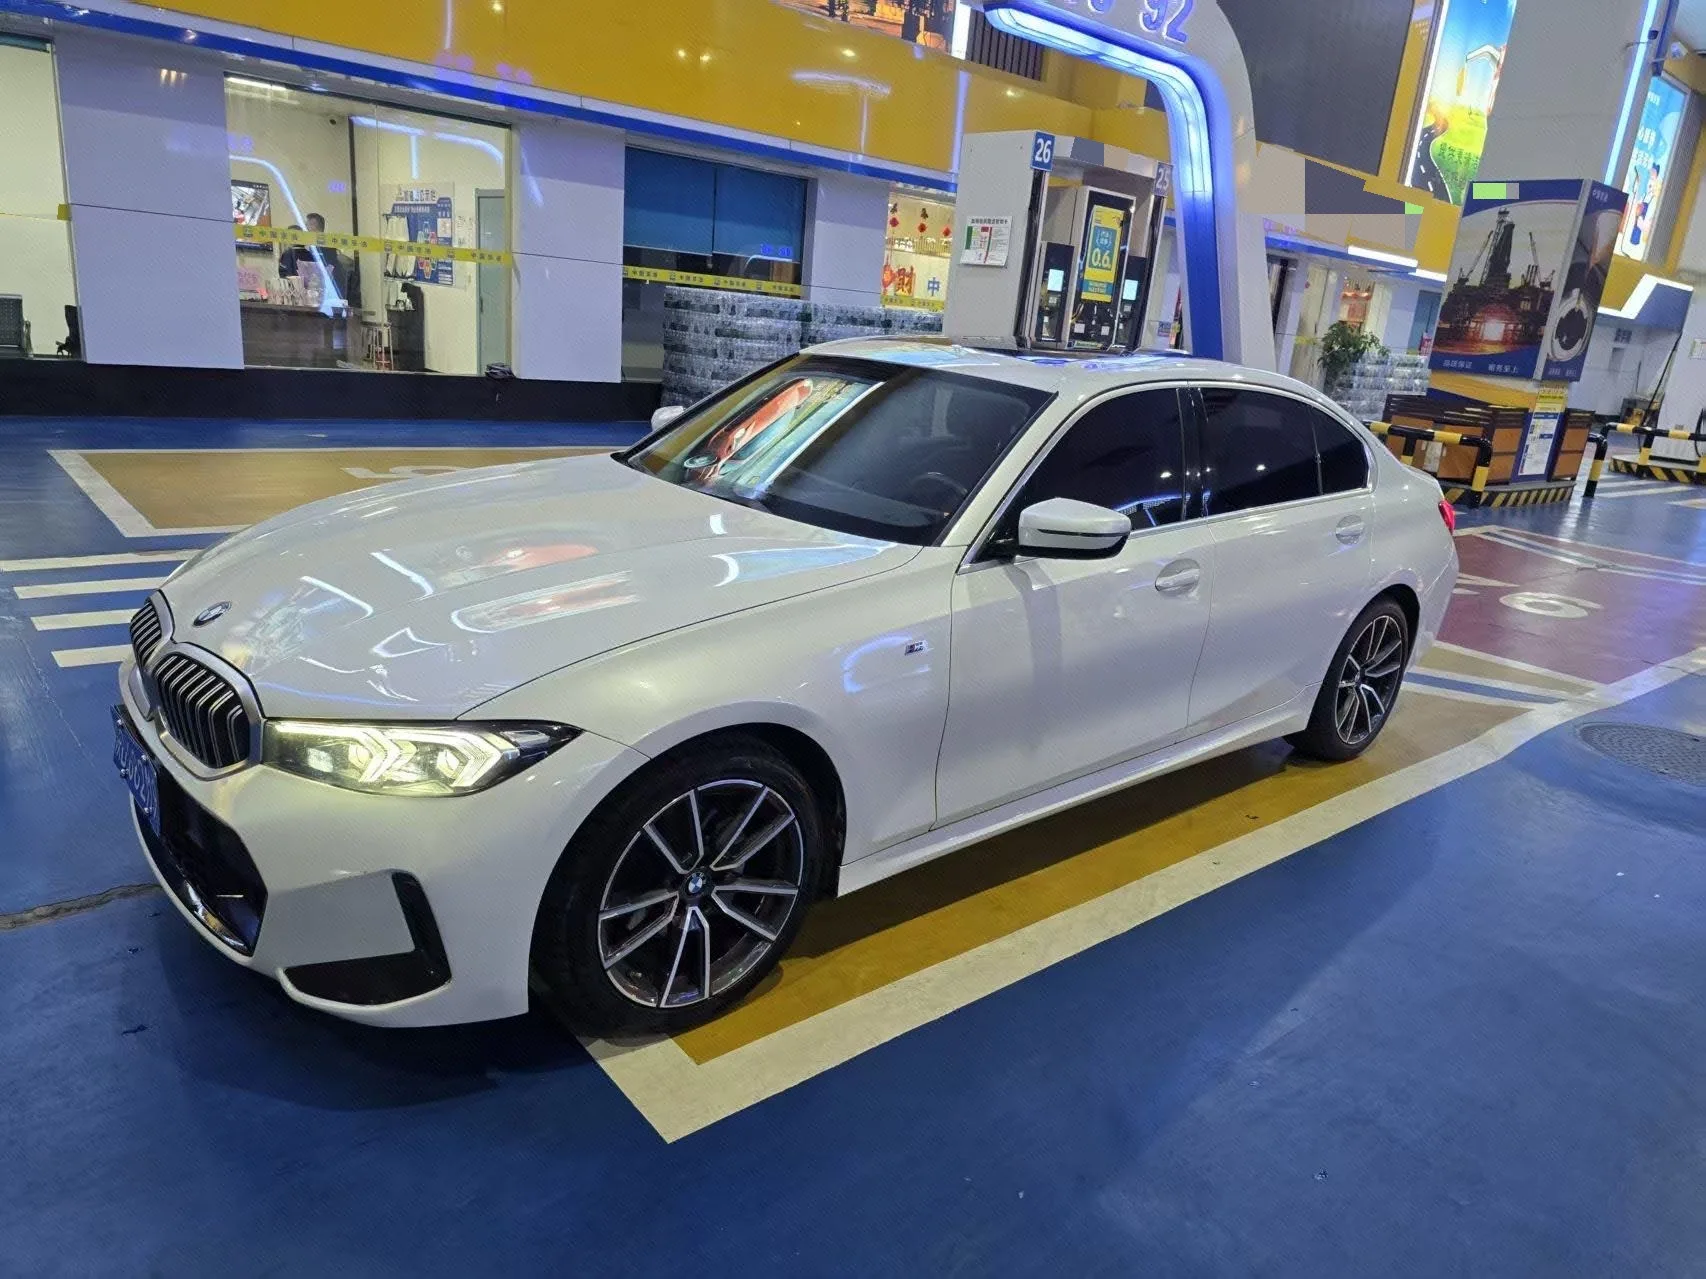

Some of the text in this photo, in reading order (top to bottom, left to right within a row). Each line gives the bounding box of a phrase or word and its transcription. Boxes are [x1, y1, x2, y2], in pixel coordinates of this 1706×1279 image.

[1035, 138, 1052, 164] 26
[1156, 169, 1170, 190] 25
[927, 277, 940, 296] 中
